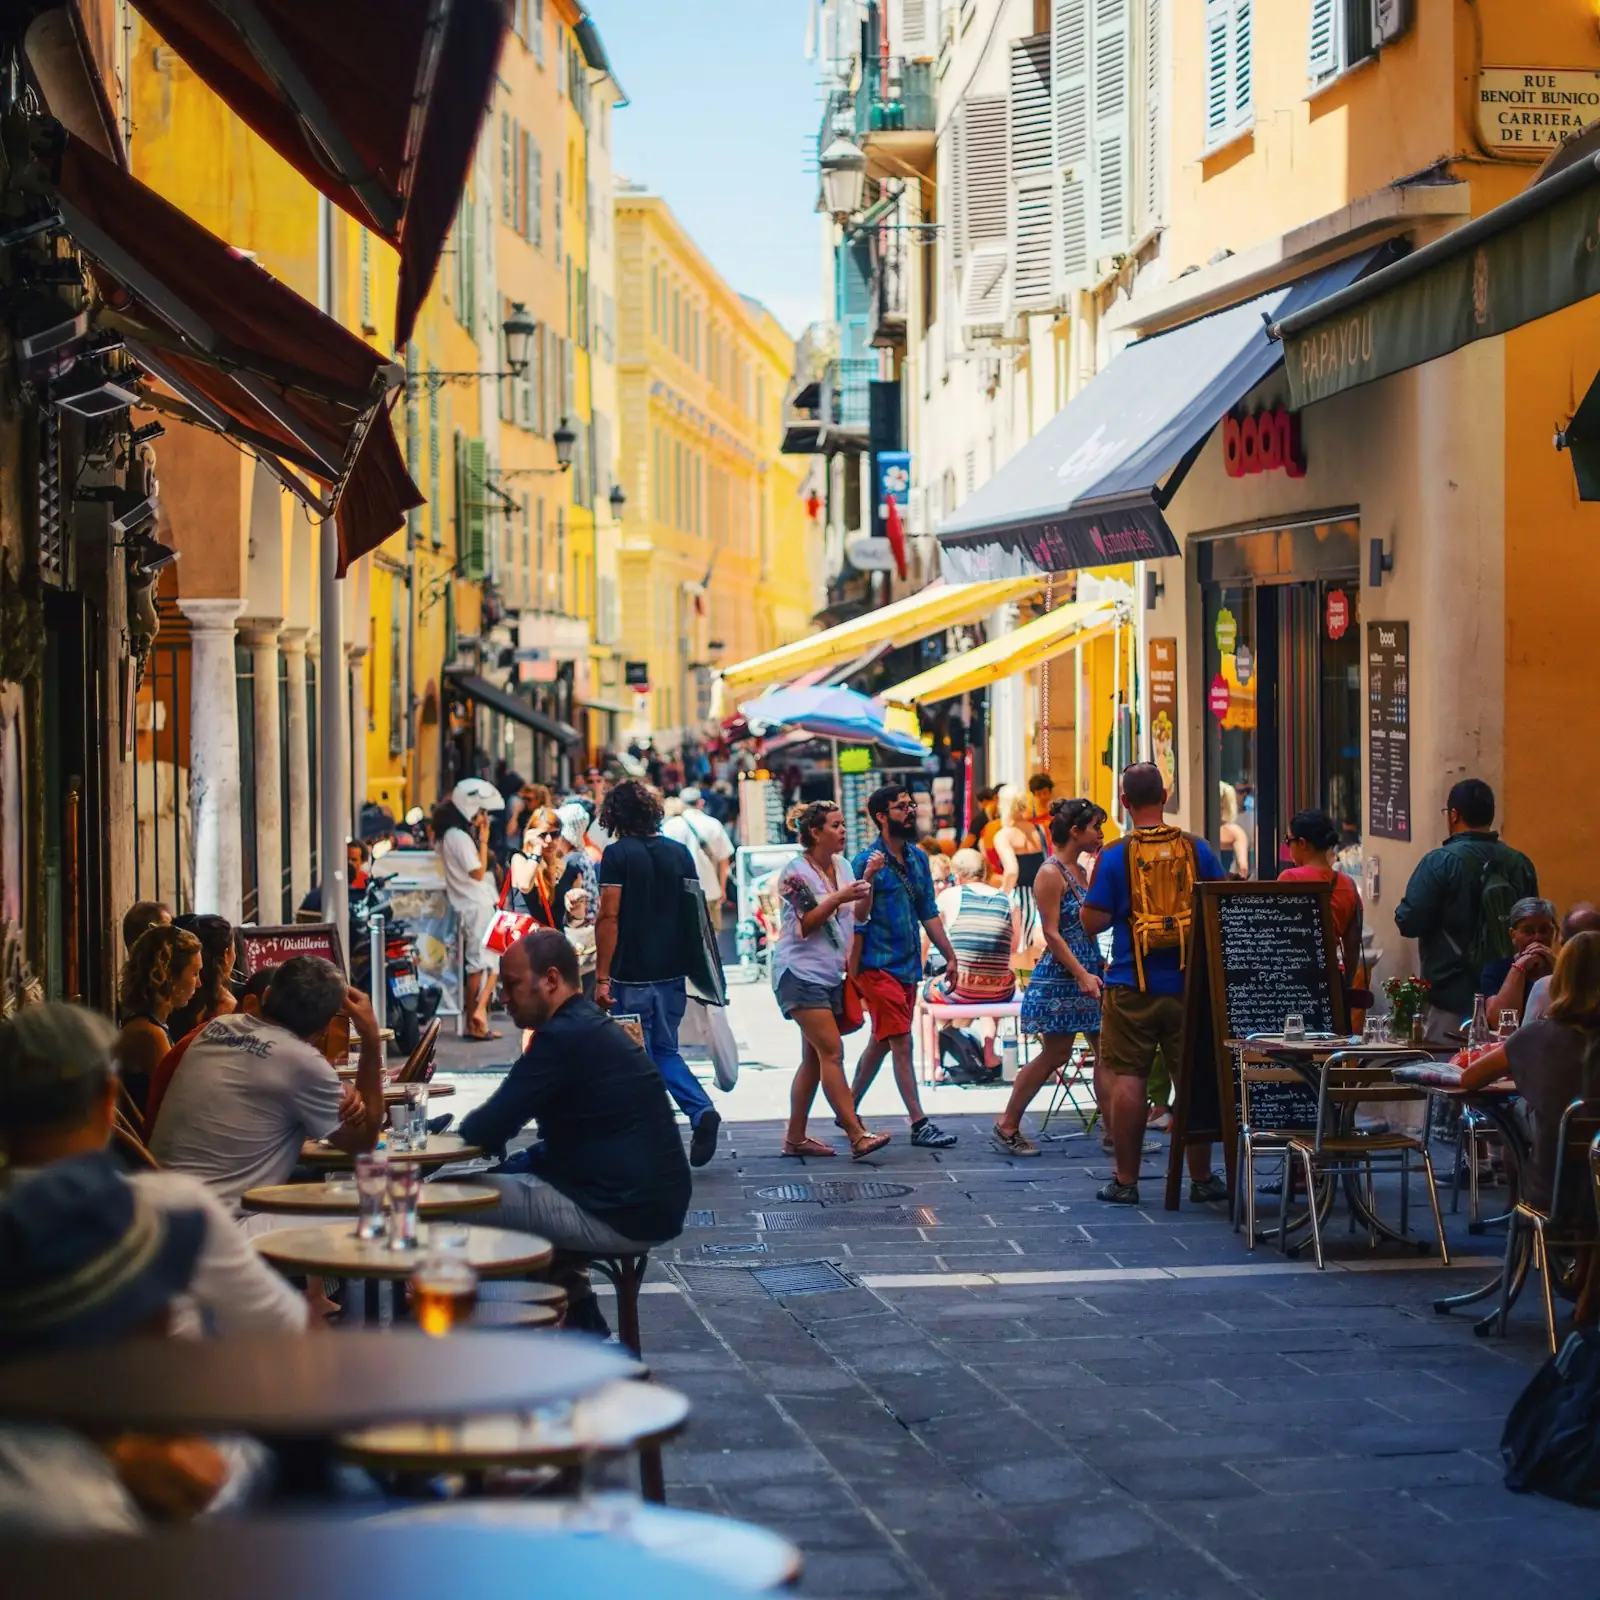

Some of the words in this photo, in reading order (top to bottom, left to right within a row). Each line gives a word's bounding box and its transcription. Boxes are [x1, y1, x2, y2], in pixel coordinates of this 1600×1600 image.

[1524, 75, 1556, 87] RUE
[1480, 90, 1536, 104] BENOÎT
[1542, 92, 1599, 105] BUNICO
[1498, 112, 1583, 126] CARRIERA
[1502, 129, 1523, 141] DE
[1302, 316, 1371, 383] PAPAYOU
